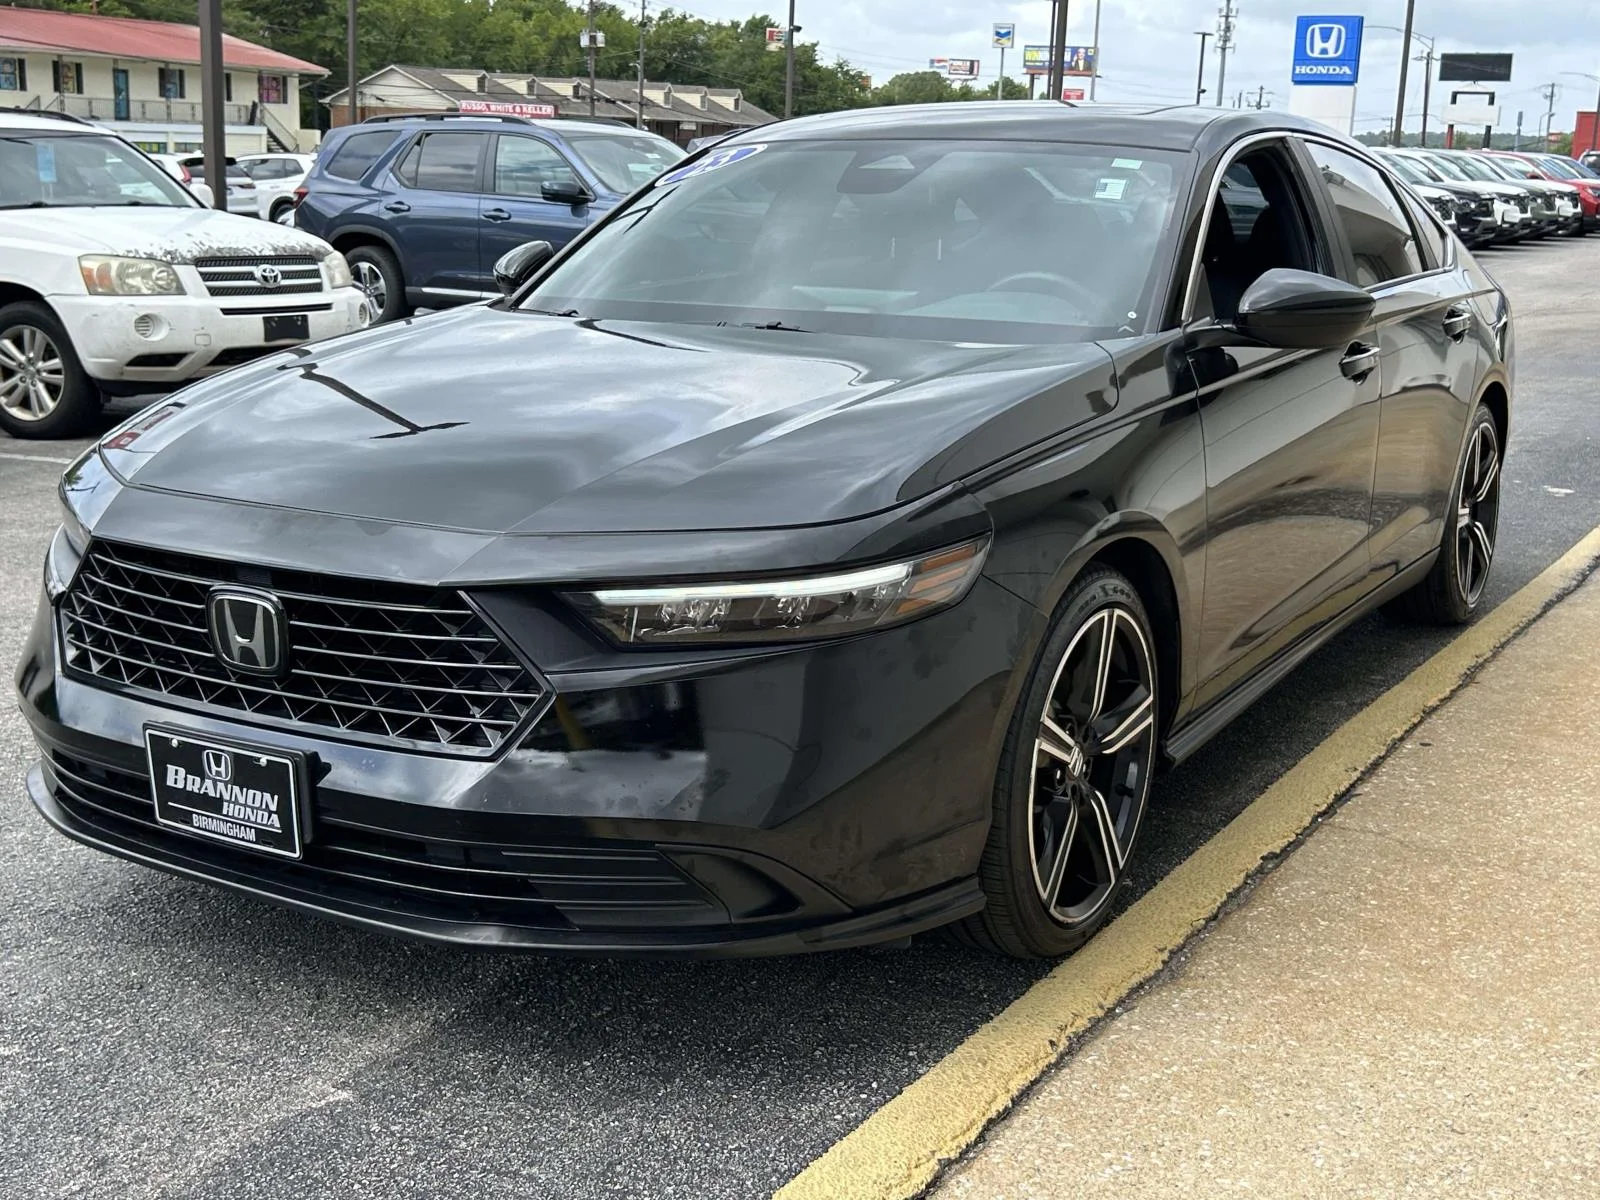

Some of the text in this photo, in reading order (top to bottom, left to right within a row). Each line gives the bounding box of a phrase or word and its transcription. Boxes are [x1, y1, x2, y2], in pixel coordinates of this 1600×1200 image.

[1294, 65, 1352, 75] HONDA
[490, 104, 515, 113] WHITE
[523, 105, 554, 115] KELLER
[222, 802, 281, 828] HONDA
[192, 814, 256, 842] BIRMINGHAM
